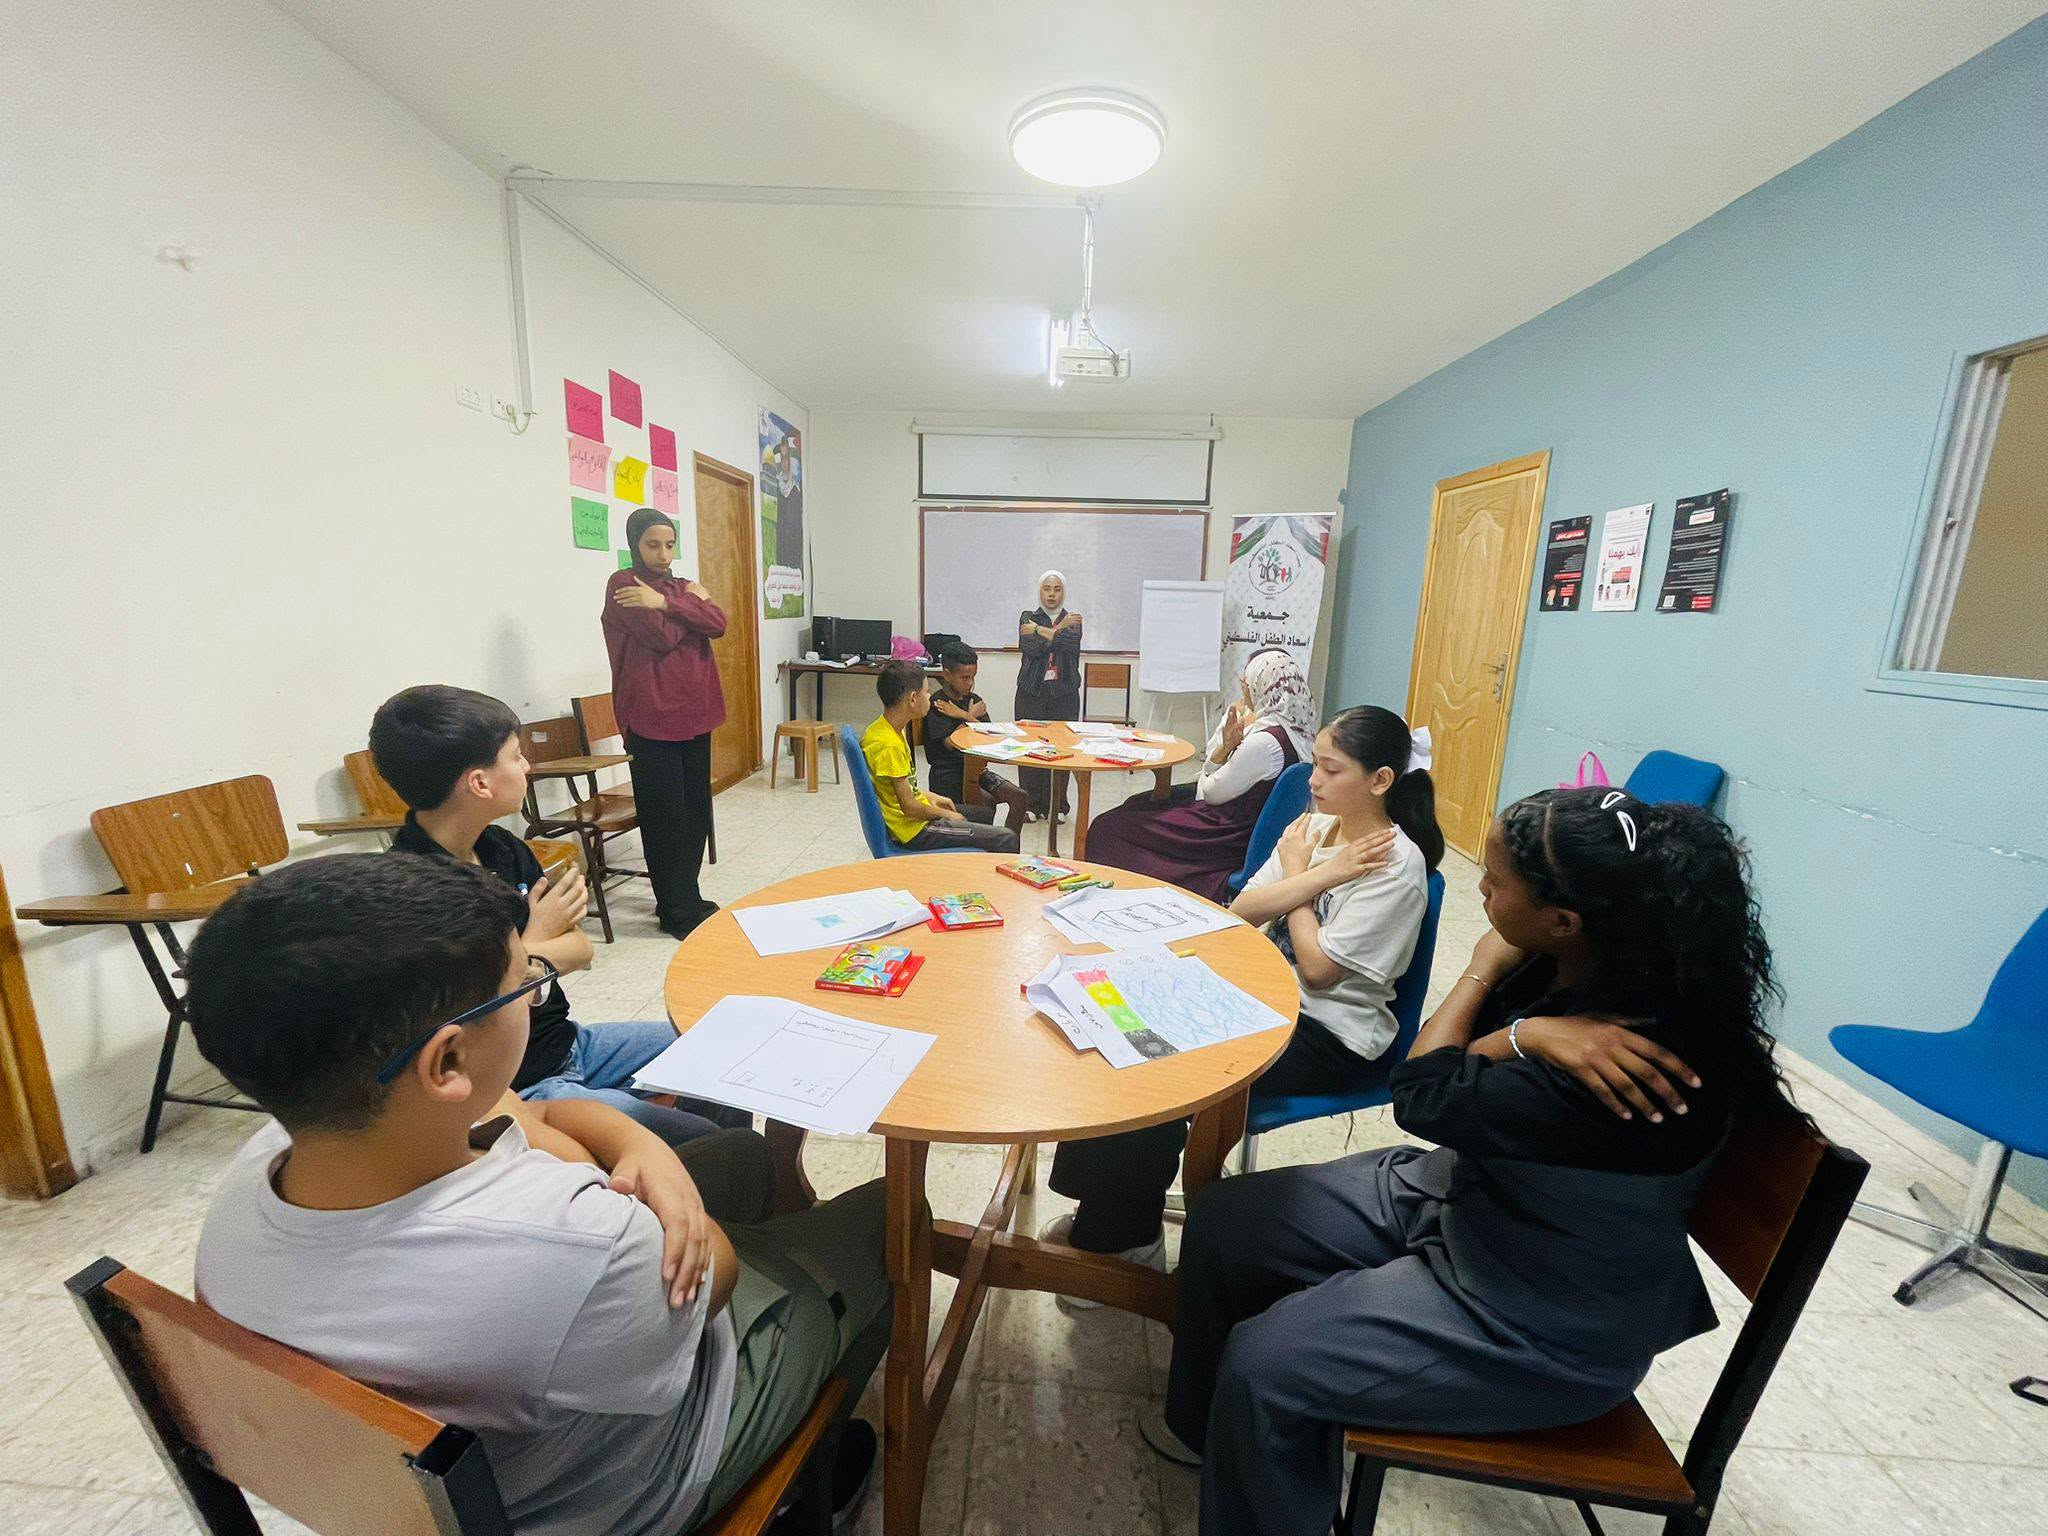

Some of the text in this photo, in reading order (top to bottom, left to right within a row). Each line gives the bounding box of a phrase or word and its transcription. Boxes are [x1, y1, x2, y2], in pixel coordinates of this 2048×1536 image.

[1247, 606, 1290, 624] جمعية
[1222, 631, 1260, 651] الفلسطيني
[1260, 632, 1286, 646] الطفل
